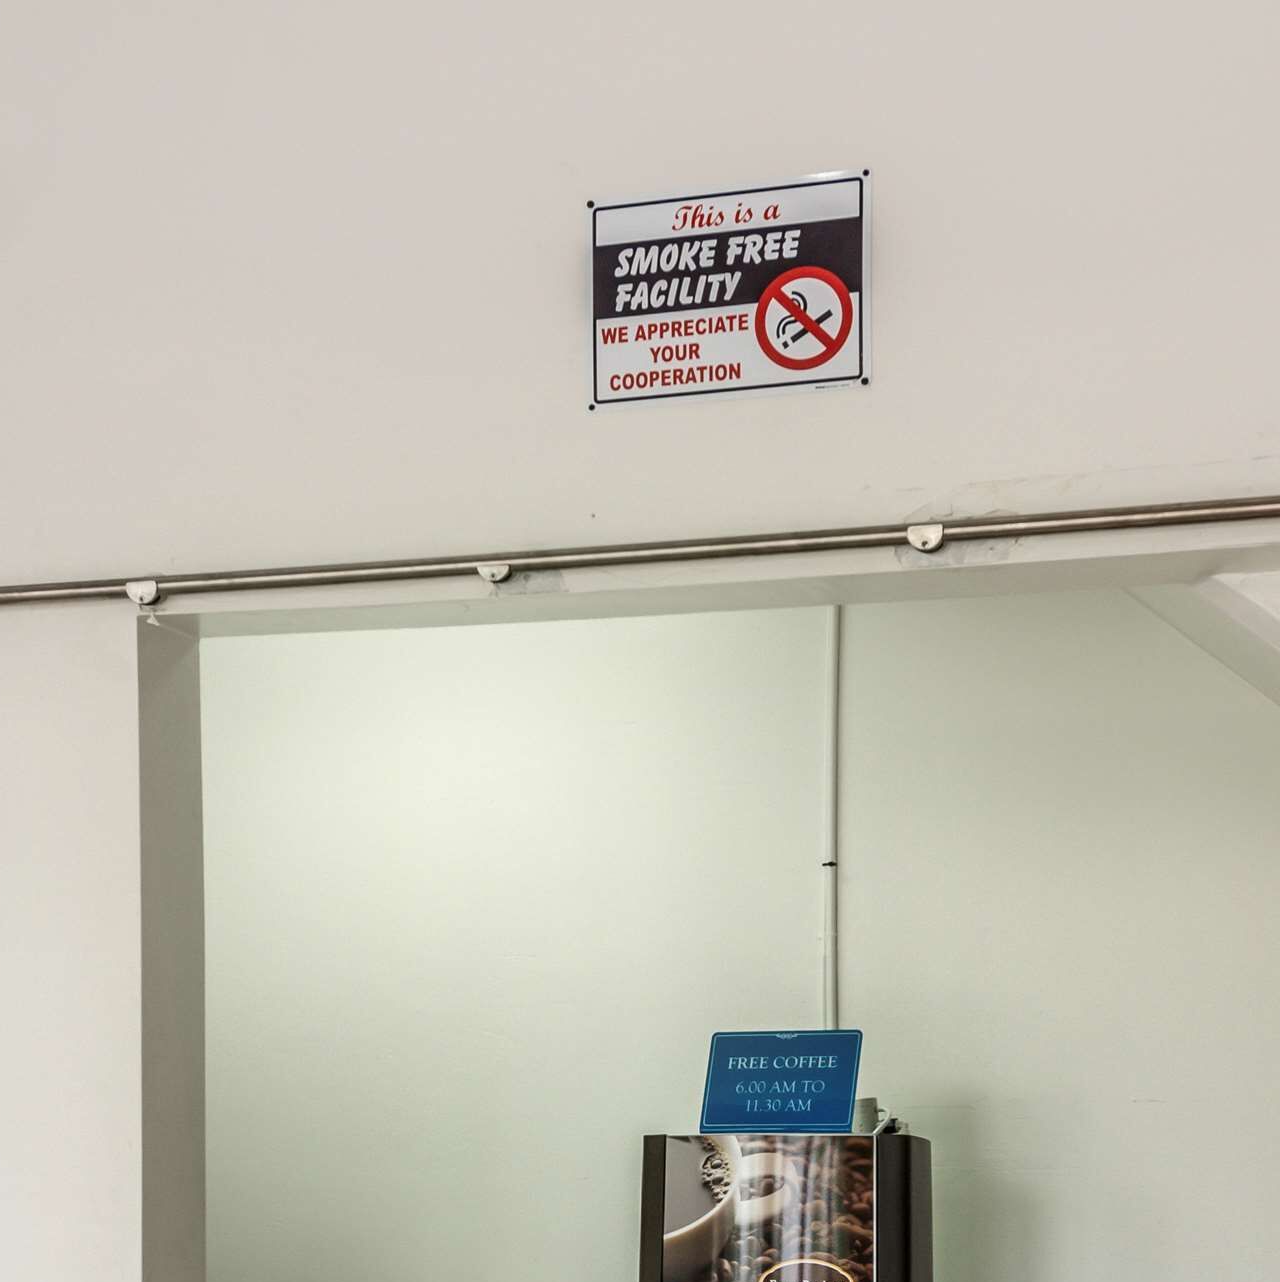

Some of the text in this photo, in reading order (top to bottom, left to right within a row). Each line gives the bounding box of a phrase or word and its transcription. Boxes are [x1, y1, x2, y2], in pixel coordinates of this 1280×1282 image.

[672, 202, 781, 231] This is a
[614, 229, 801, 278] SMOKE FREE
[615, 271, 742, 312] FACILITY
[601, 313, 749, 345] WE APPRECIATE
[649, 343, 700, 363] YOUR
[609, 362, 742, 391] COOPERATION
[728, 1056, 838, 1070] FREE COFFEE
[735, 1080, 826, 1094] 6.00 AM TO
[746, 1099, 812, 1112] 11.30 AM
